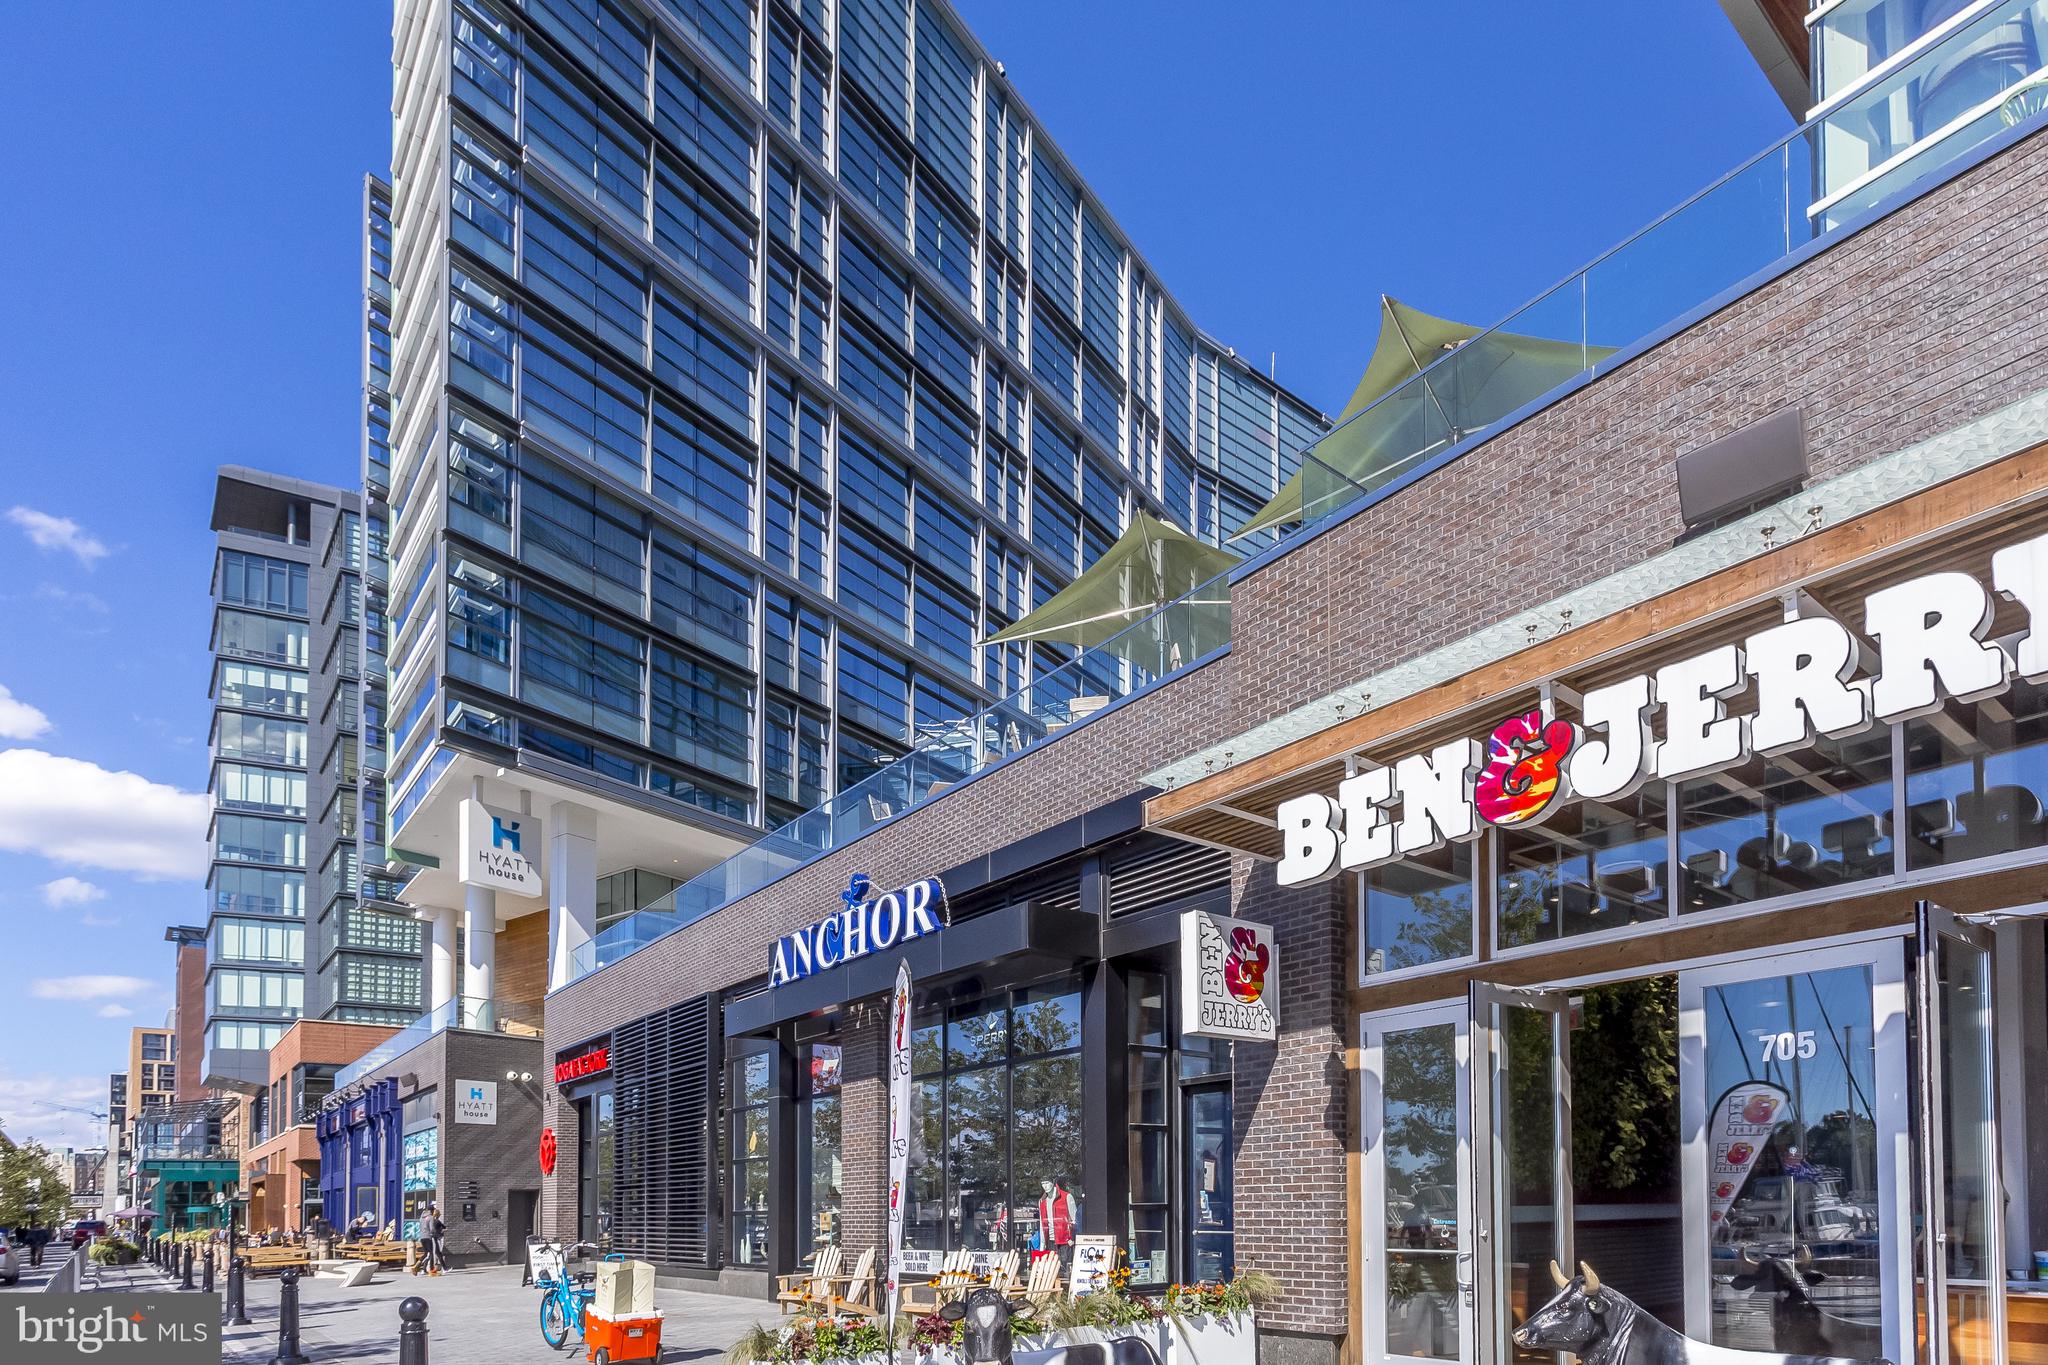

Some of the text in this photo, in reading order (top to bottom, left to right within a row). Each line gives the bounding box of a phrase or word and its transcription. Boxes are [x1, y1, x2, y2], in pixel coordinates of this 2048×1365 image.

[1277, 737, 1482, 889] BEN
[479, 850, 533, 874] HYATT
[488, 865, 524, 882] house
[768, 878, 940, 990] ANCHOR
[1200, 922, 1223, 998] BEN
[1201, 1001, 1271, 1032] JERRY'S
[1758, 1030, 1817, 1062] 705
[458, 1101, 494, 1111] HYATT
[463, 1110, 489, 1118] house
[903, 1251, 914, 1261] BEER
[919, 1252, 930, 1262] WINE
[905, 1262, 928, 1272] SOLD HERE
